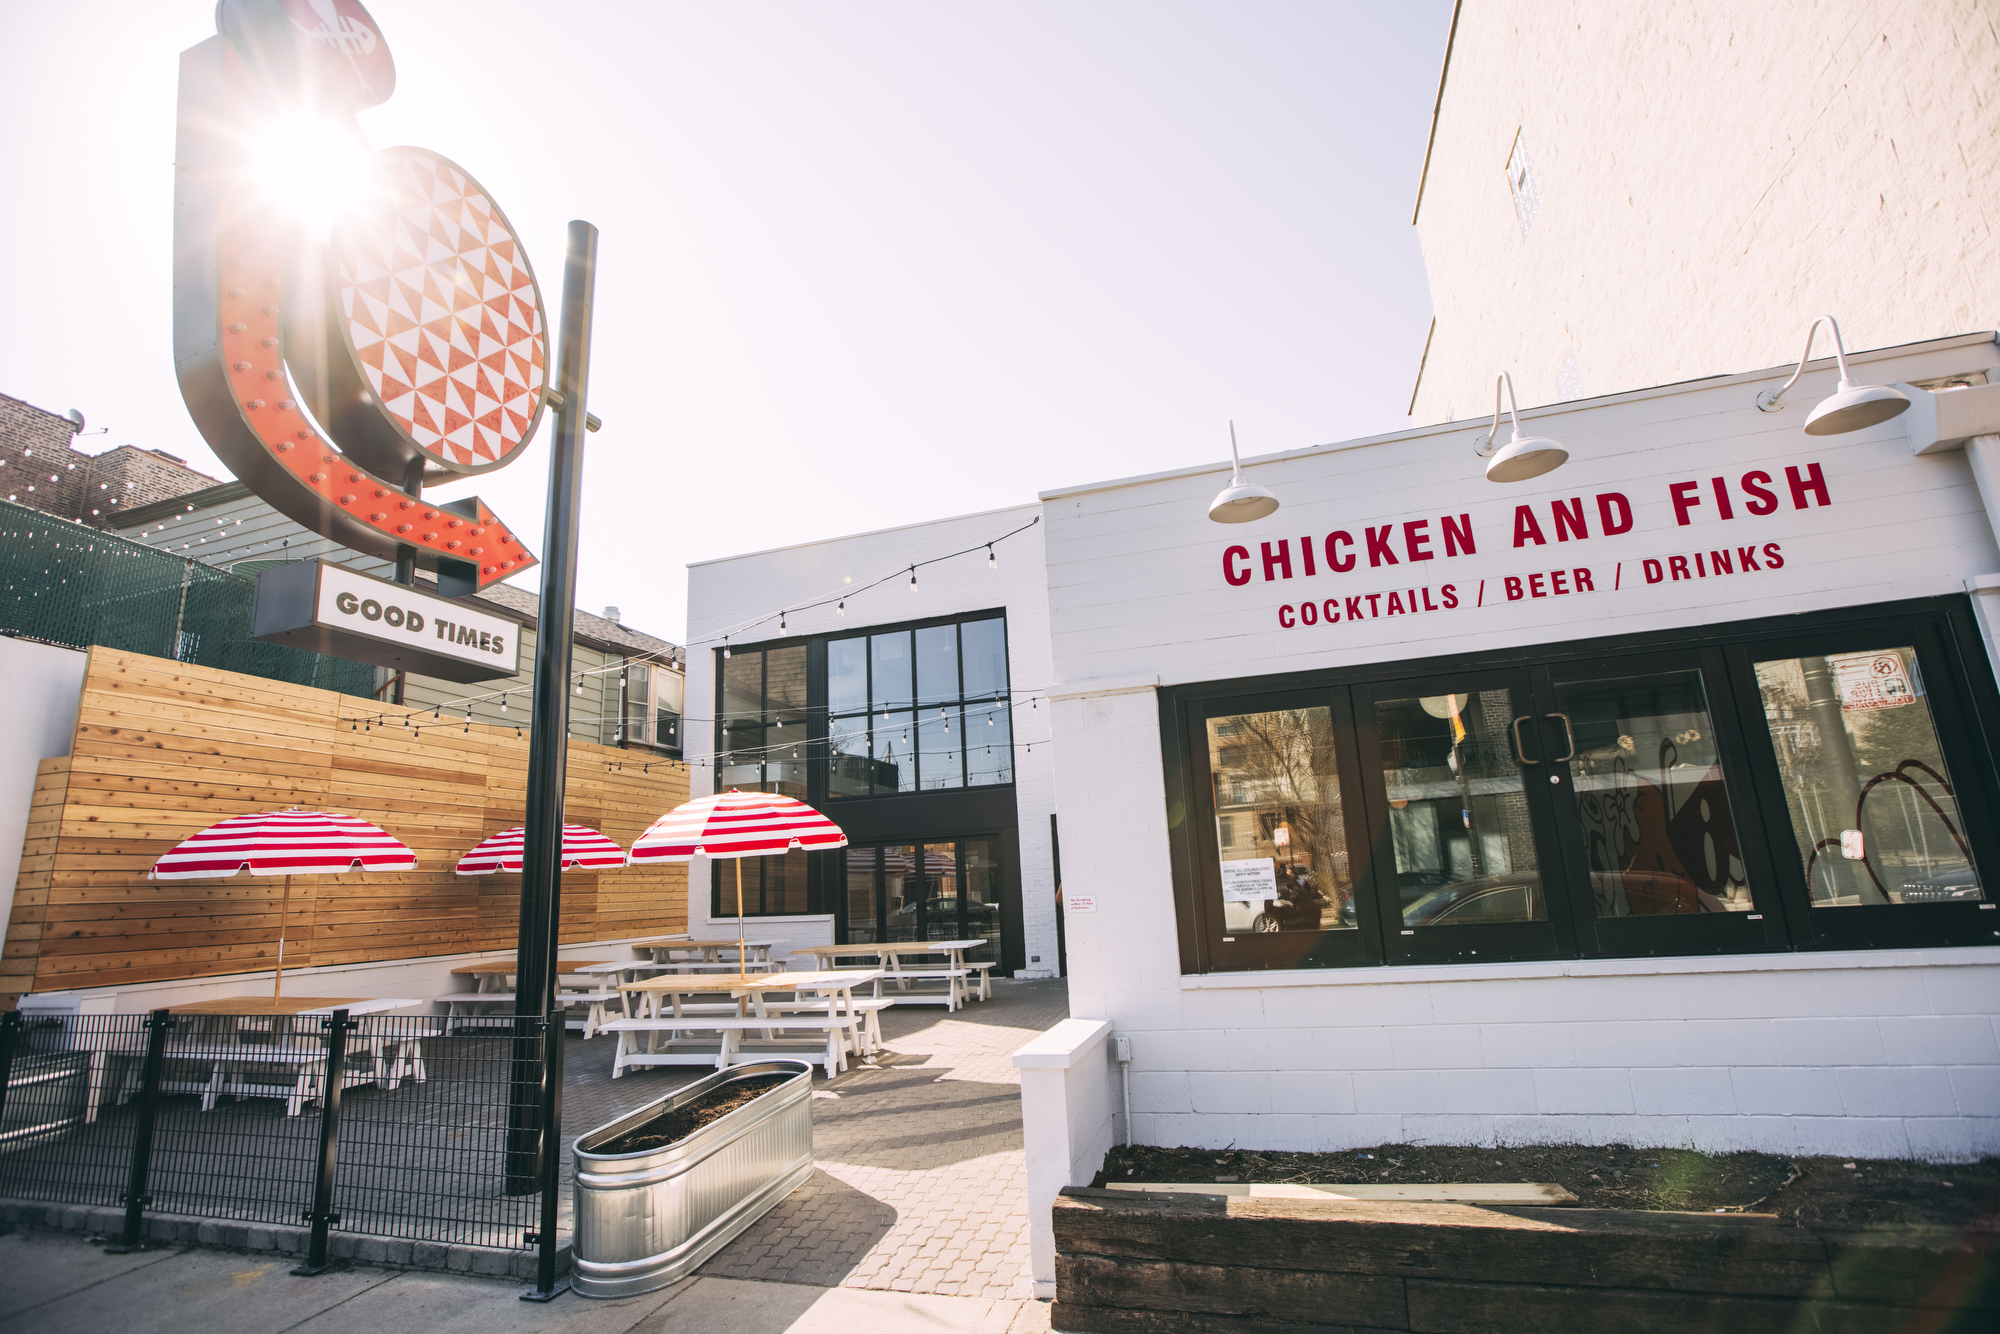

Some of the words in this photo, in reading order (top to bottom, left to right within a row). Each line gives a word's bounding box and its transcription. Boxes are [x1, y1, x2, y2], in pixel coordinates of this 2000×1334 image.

[1222, 513, 1477, 587] CHICKEN
[1512, 492, 1634, 549] AND
[1668, 462, 1832, 527] FISH
[336, 592, 425, 633] GOOD
[434, 618, 504, 655] TIMES
[1278, 583, 1459, 629] COCKTAILS
[1477, 579, 1486, 608] /
[1503, 567, 1595, 602] BEER
[1613, 562, 1622, 591] /
[1641, 542, 1784, 585] DRINKS
